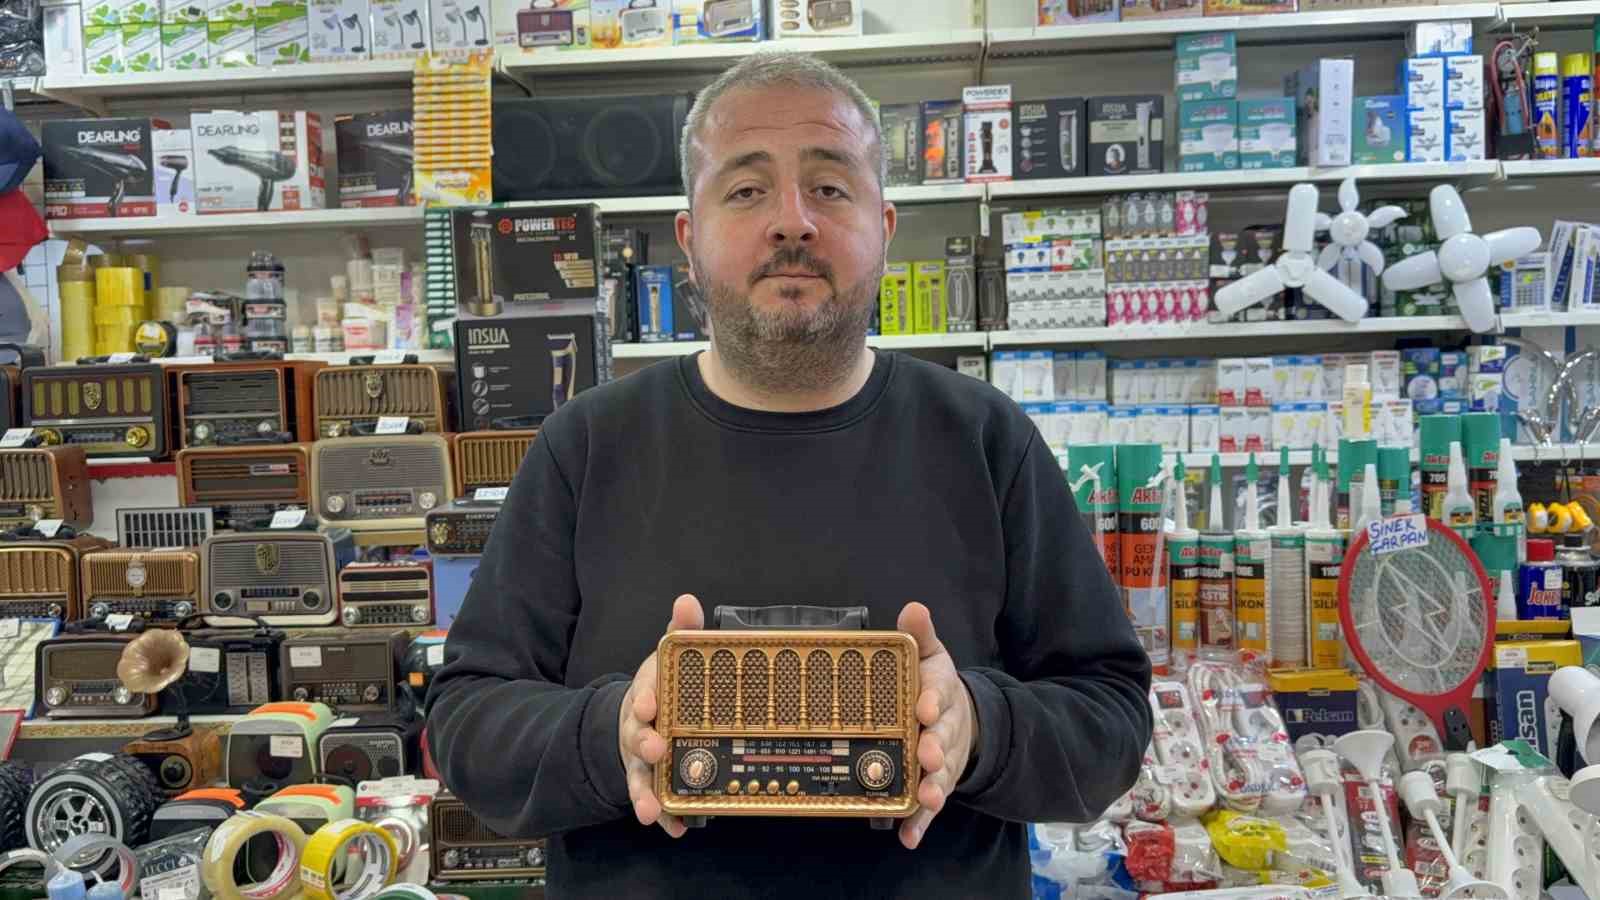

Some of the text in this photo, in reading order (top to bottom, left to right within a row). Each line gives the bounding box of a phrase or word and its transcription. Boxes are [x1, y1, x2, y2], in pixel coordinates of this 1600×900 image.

[198, 124, 259, 137] DEARLING
[367, 121, 414, 136] DEARLIN
[78, 130, 141, 144] DEARLING
[514, 216, 576, 233] POWERTEC
[468, 327, 510, 345] INSUA
[675, 738, 719, 748] EVERTON
